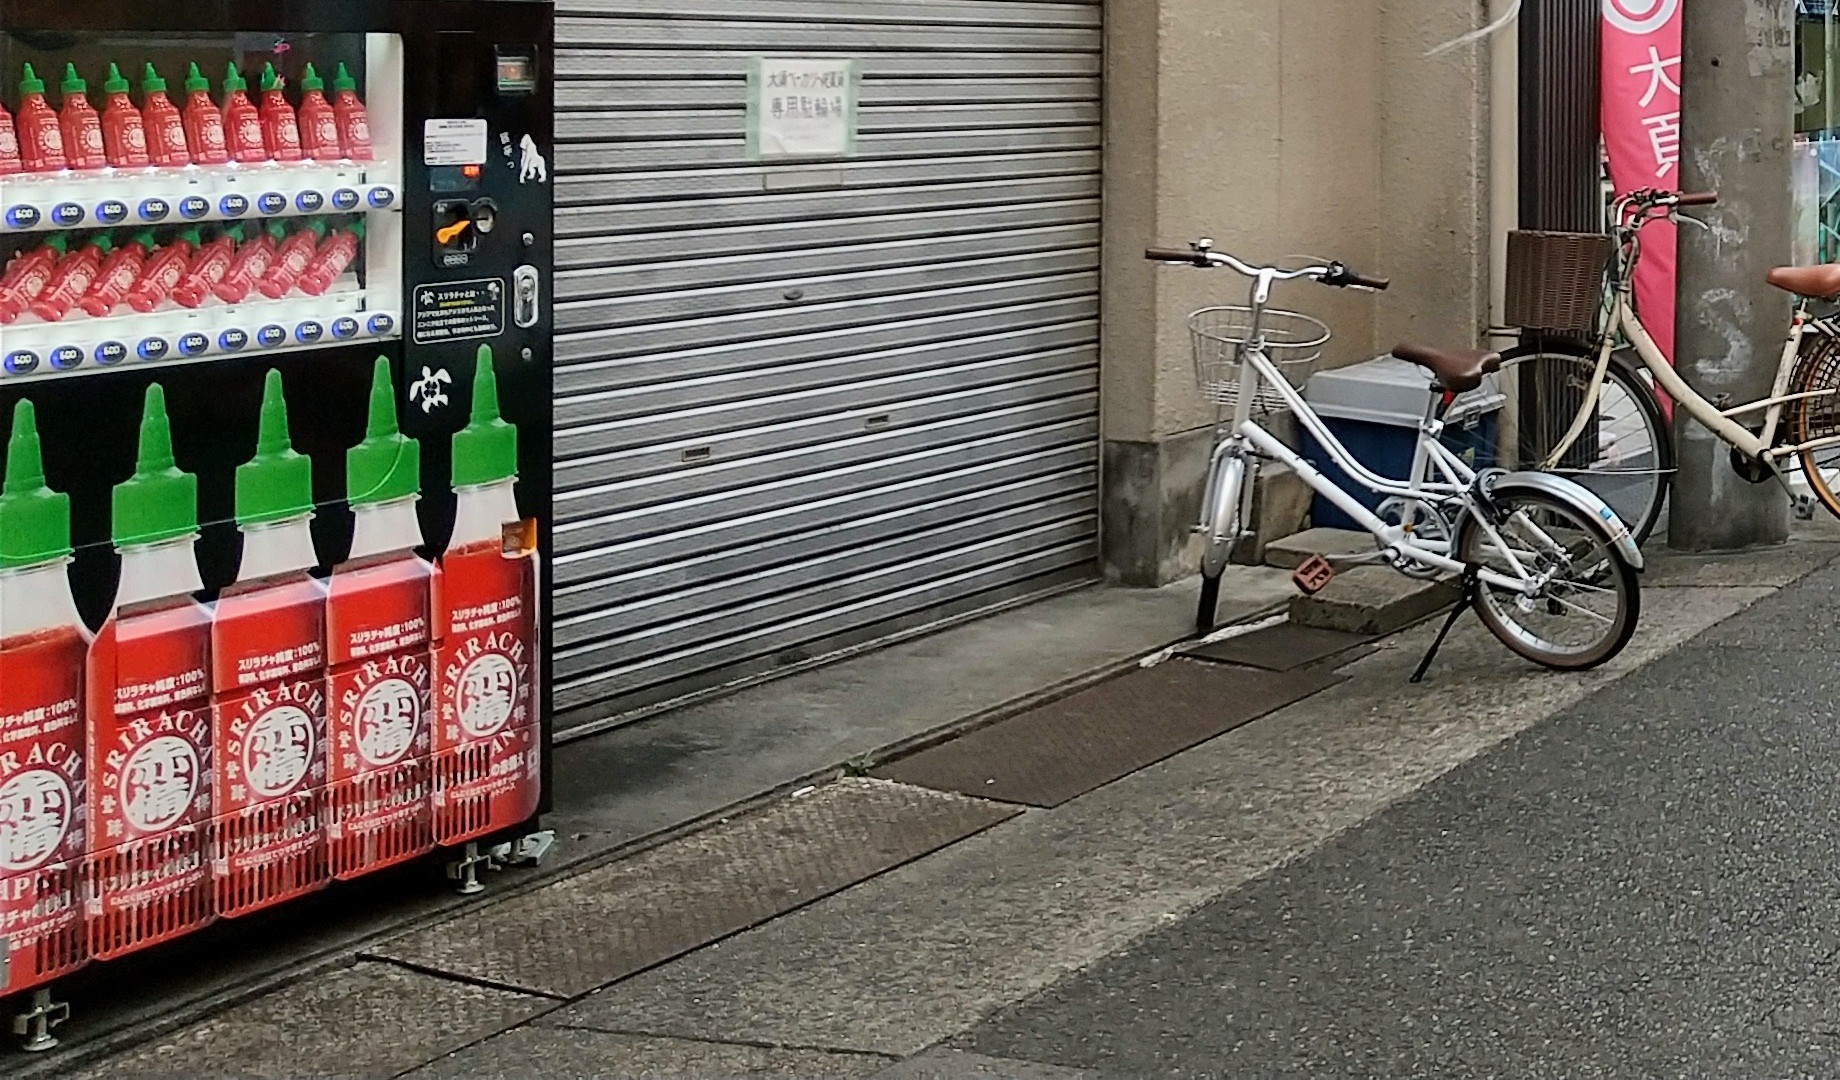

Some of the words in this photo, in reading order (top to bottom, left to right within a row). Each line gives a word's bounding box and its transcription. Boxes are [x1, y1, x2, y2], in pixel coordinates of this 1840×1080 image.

[340, 655, 431, 726] SRIRACHA
[443, 630, 529, 699] SRIRACHA
[102, 710, 213, 790] SRIRACHA
[227, 680, 327, 757] SRIRACHA
